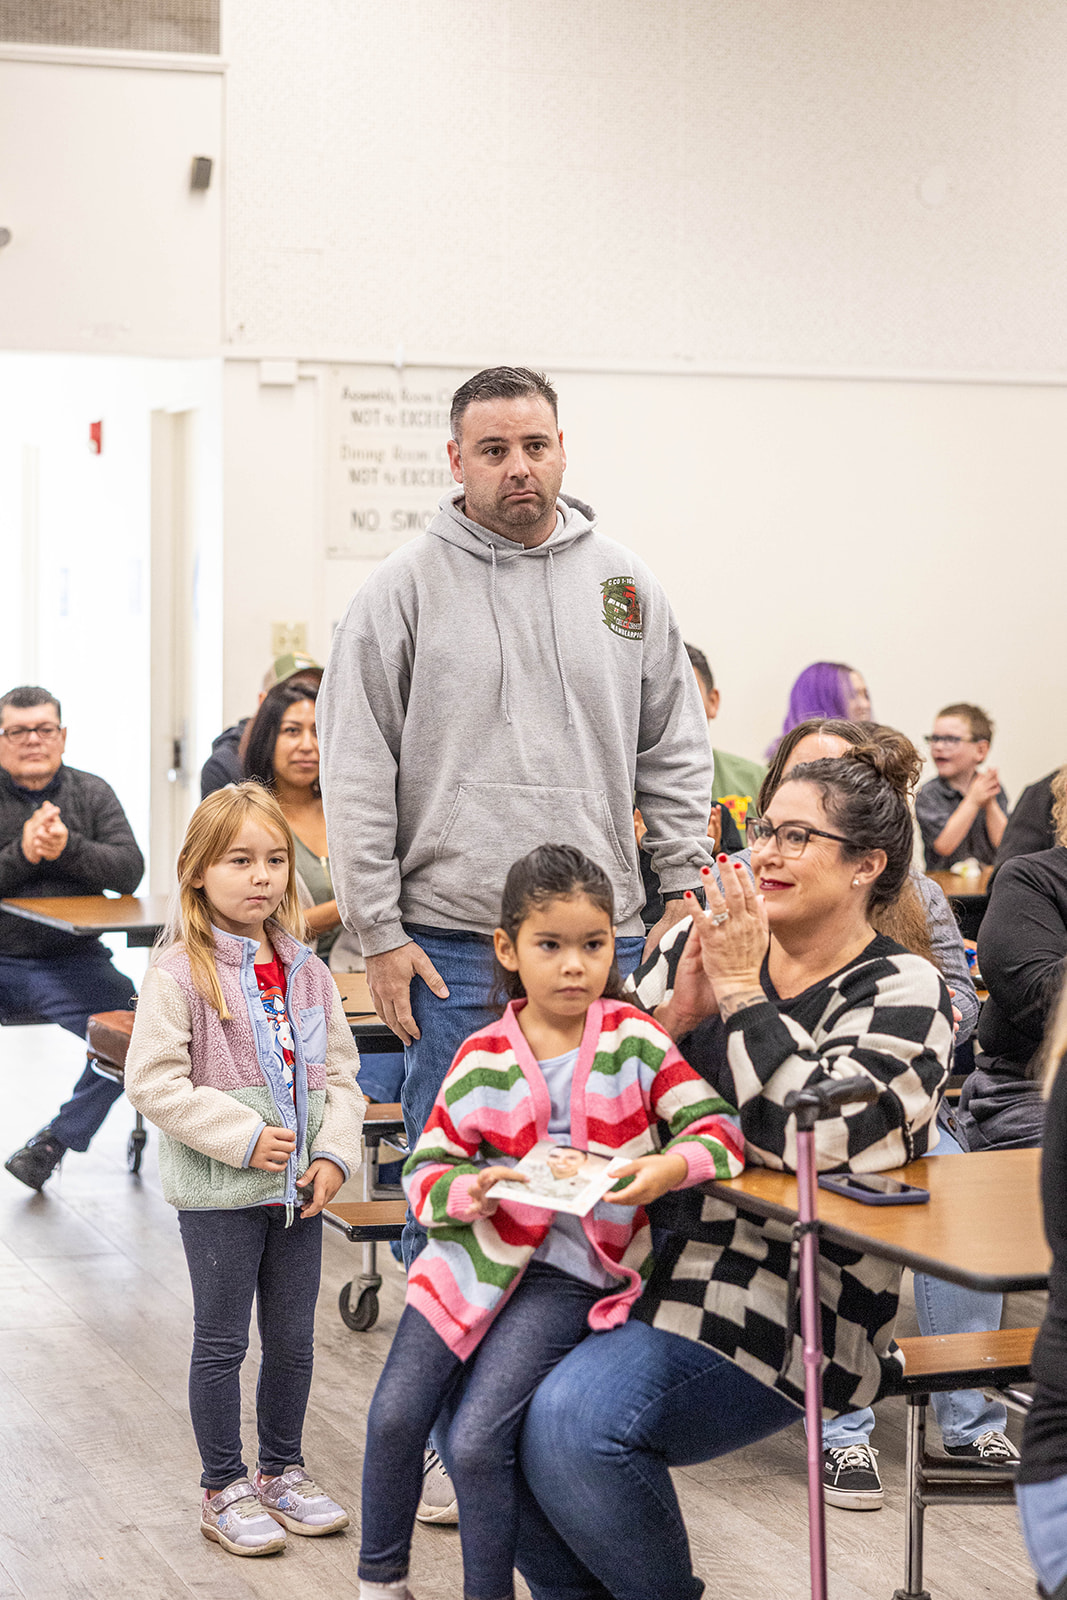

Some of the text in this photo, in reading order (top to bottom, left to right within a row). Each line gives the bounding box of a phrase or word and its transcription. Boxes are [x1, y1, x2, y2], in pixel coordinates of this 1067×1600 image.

[342, 386, 396, 406] Assembly
[400, 387, 432, 403] Room
[351, 410, 380, 426] NOT
[340, 444, 385, 463] Dining
[392, 445, 427, 461] Room
[349, 468, 378, 485] NOT
[350, 509, 436, 531] NO SMO
